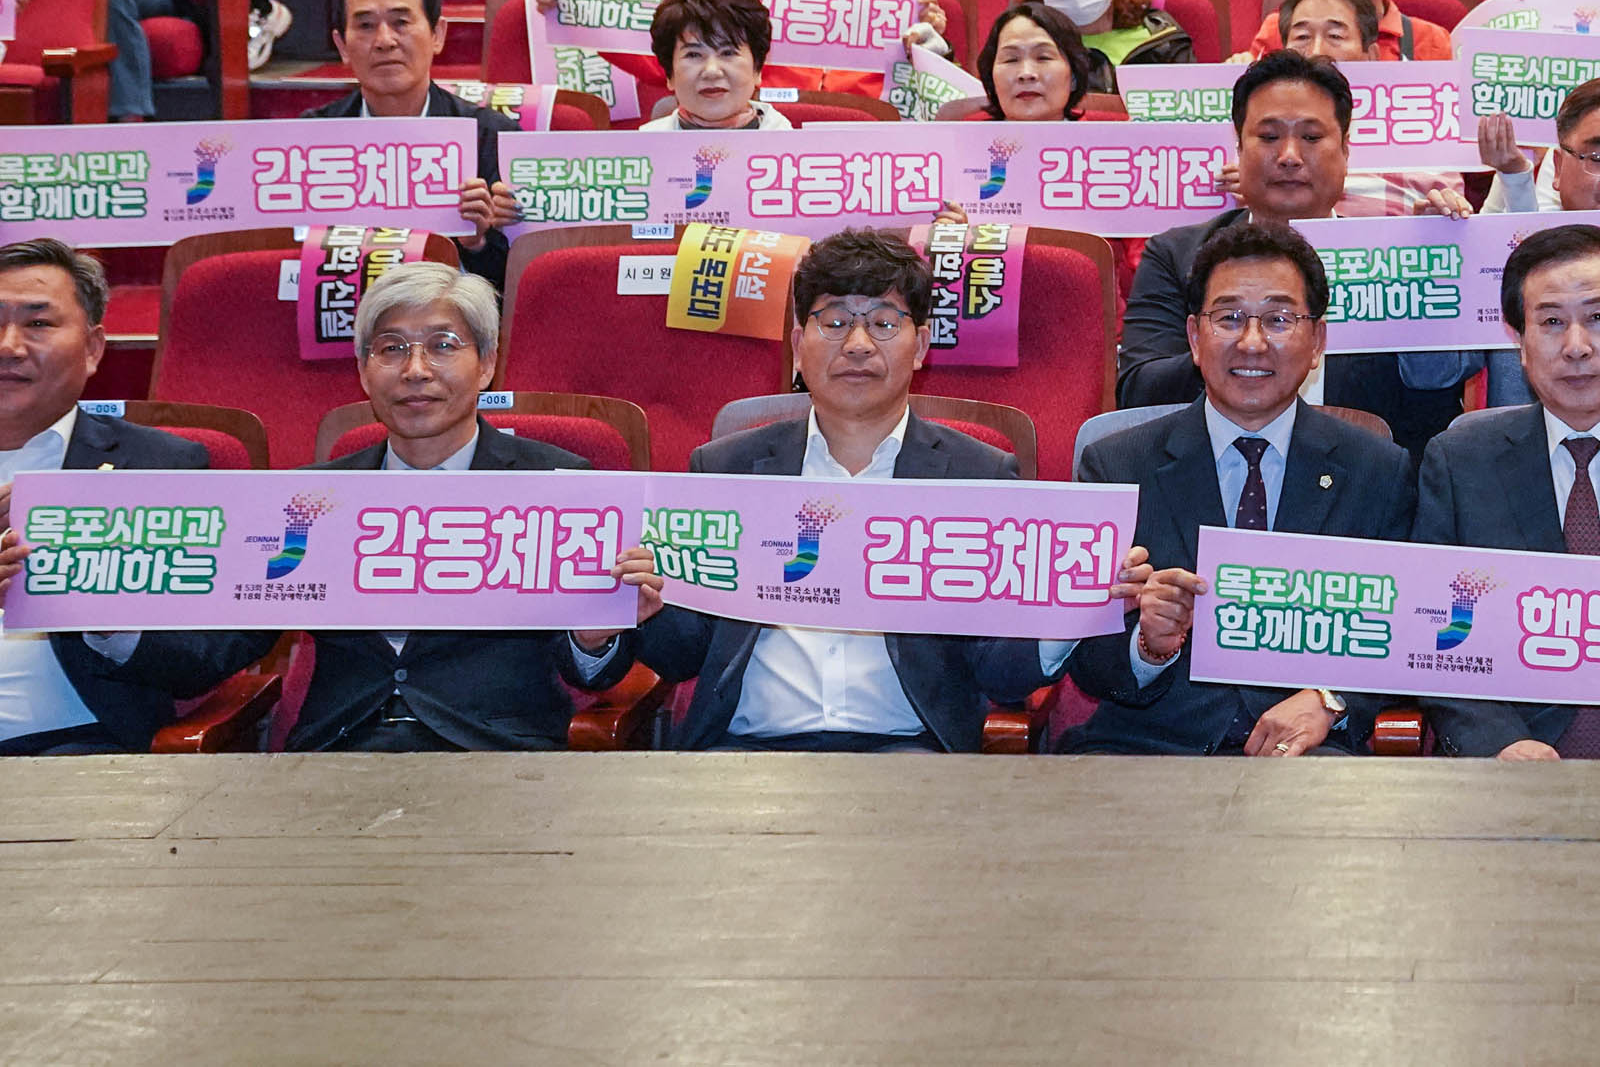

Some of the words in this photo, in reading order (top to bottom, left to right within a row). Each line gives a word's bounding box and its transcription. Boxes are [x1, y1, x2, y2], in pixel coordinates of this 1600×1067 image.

[1126, 87, 1234, 121] 목포시민
[1348, 82, 1461, 146] 감동
[1471, 82, 1565, 120] 함께하
[0, 152, 149, 183] 목포시민과
[252, 141, 462, 213] 감동체전
[509, 156, 653, 187] 목포시민과
[747, 151, 945, 219] 감동체전
[1040, 145, 1227, 210] 감동체전
[0, 182, 147, 221] 함께하는
[516, 185, 651, 223] 함께하는
[366, 246, 404, 288] 해
[734, 253, 771, 302] 신설
[965, 257, 1003, 318] 해소
[318, 279, 358, 342] 신설
[686, 259, 729, 321] 목포대
[926, 286, 960, 346] 신설
[27, 506, 226, 547] 목포시민과
[244, 535, 280, 543] JEONNAM
[260, 543, 280, 552] 2024
[642, 508, 743, 550] 시민과
[760, 540, 794, 549] JEONNAM
[25, 546, 218, 595] 함께하는
[356, 505, 626, 596] 감동체전
[642, 545, 740, 592] 하는
[775, 548, 793, 556] 2024
[863, 514, 1118, 608] 감동체전
[1216, 564, 1399, 614] 목포시민과
[1215, 603, 1393, 659] 함께하는
[1414, 607, 1447, 616] JEONNAM
[1429, 616, 1447, 624] 2024
